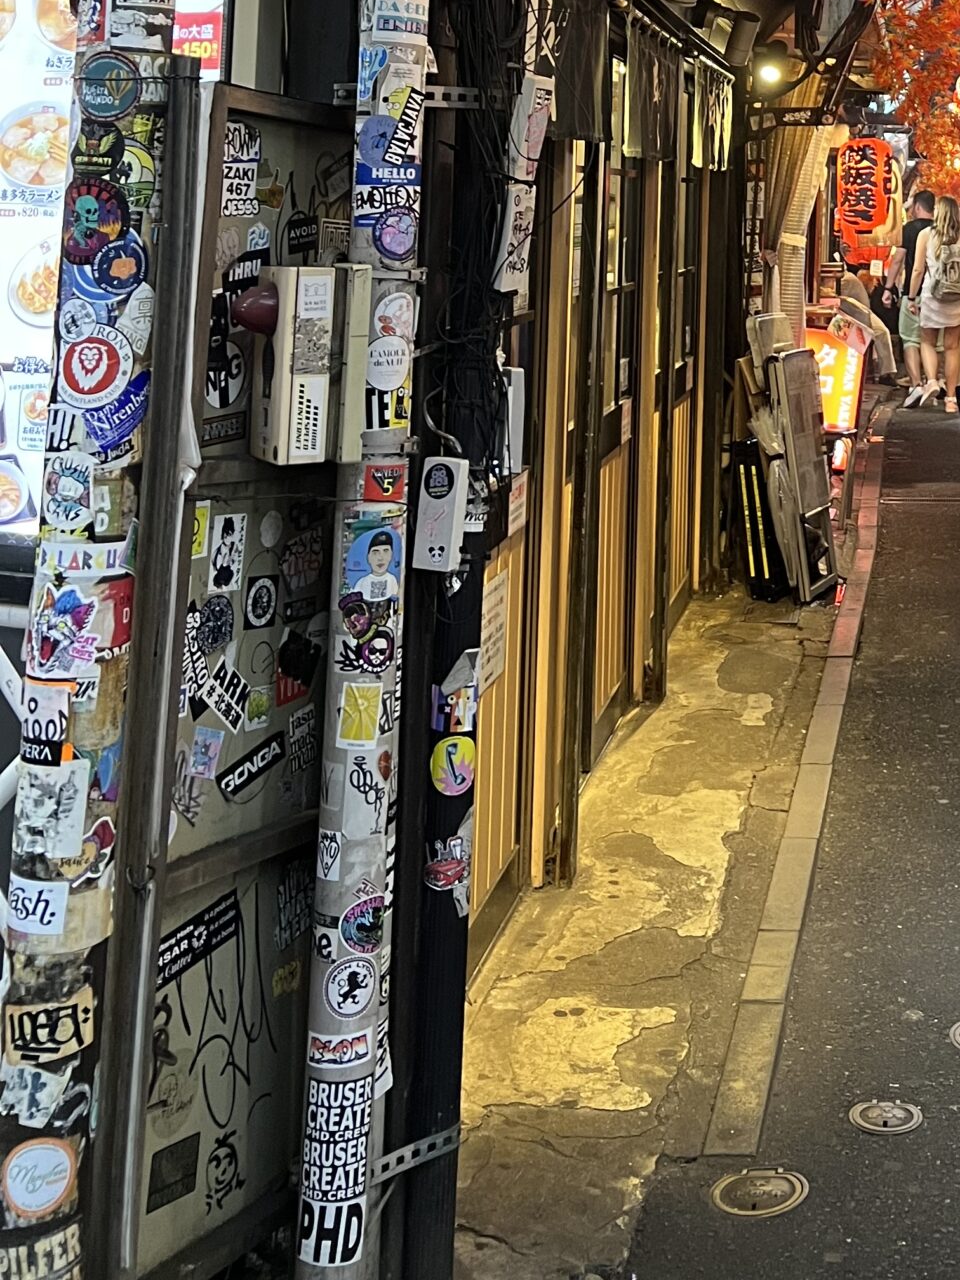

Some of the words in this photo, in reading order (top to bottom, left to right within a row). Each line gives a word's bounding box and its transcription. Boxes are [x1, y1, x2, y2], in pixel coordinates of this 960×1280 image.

[224, 165, 255, 180] ZAKI
[371, 167, 417, 180] HELLO
[226, 182, 251, 197] 467
[840, 143, 878, 226] 鉄板焼き
[0, 189, 62, 204] 喜多方ラーメン
[223, 199, 260, 216] JESS3
[289, 224, 318, 240] AVOID
[228, 258, 262, 282] THRU
[308, 1076, 373, 1108] BRUSER
[307, 1099, 372, 1132] CREATE
[305, 1124, 370, 1142] PHD.CREW
[303, 1136, 367, 1167] BRUSER
[302, 1158, 366, 1192] CREATE
[301, 1182, 365, 1202] PHD.CREW
[301, 1202, 364, 1265] PHD
